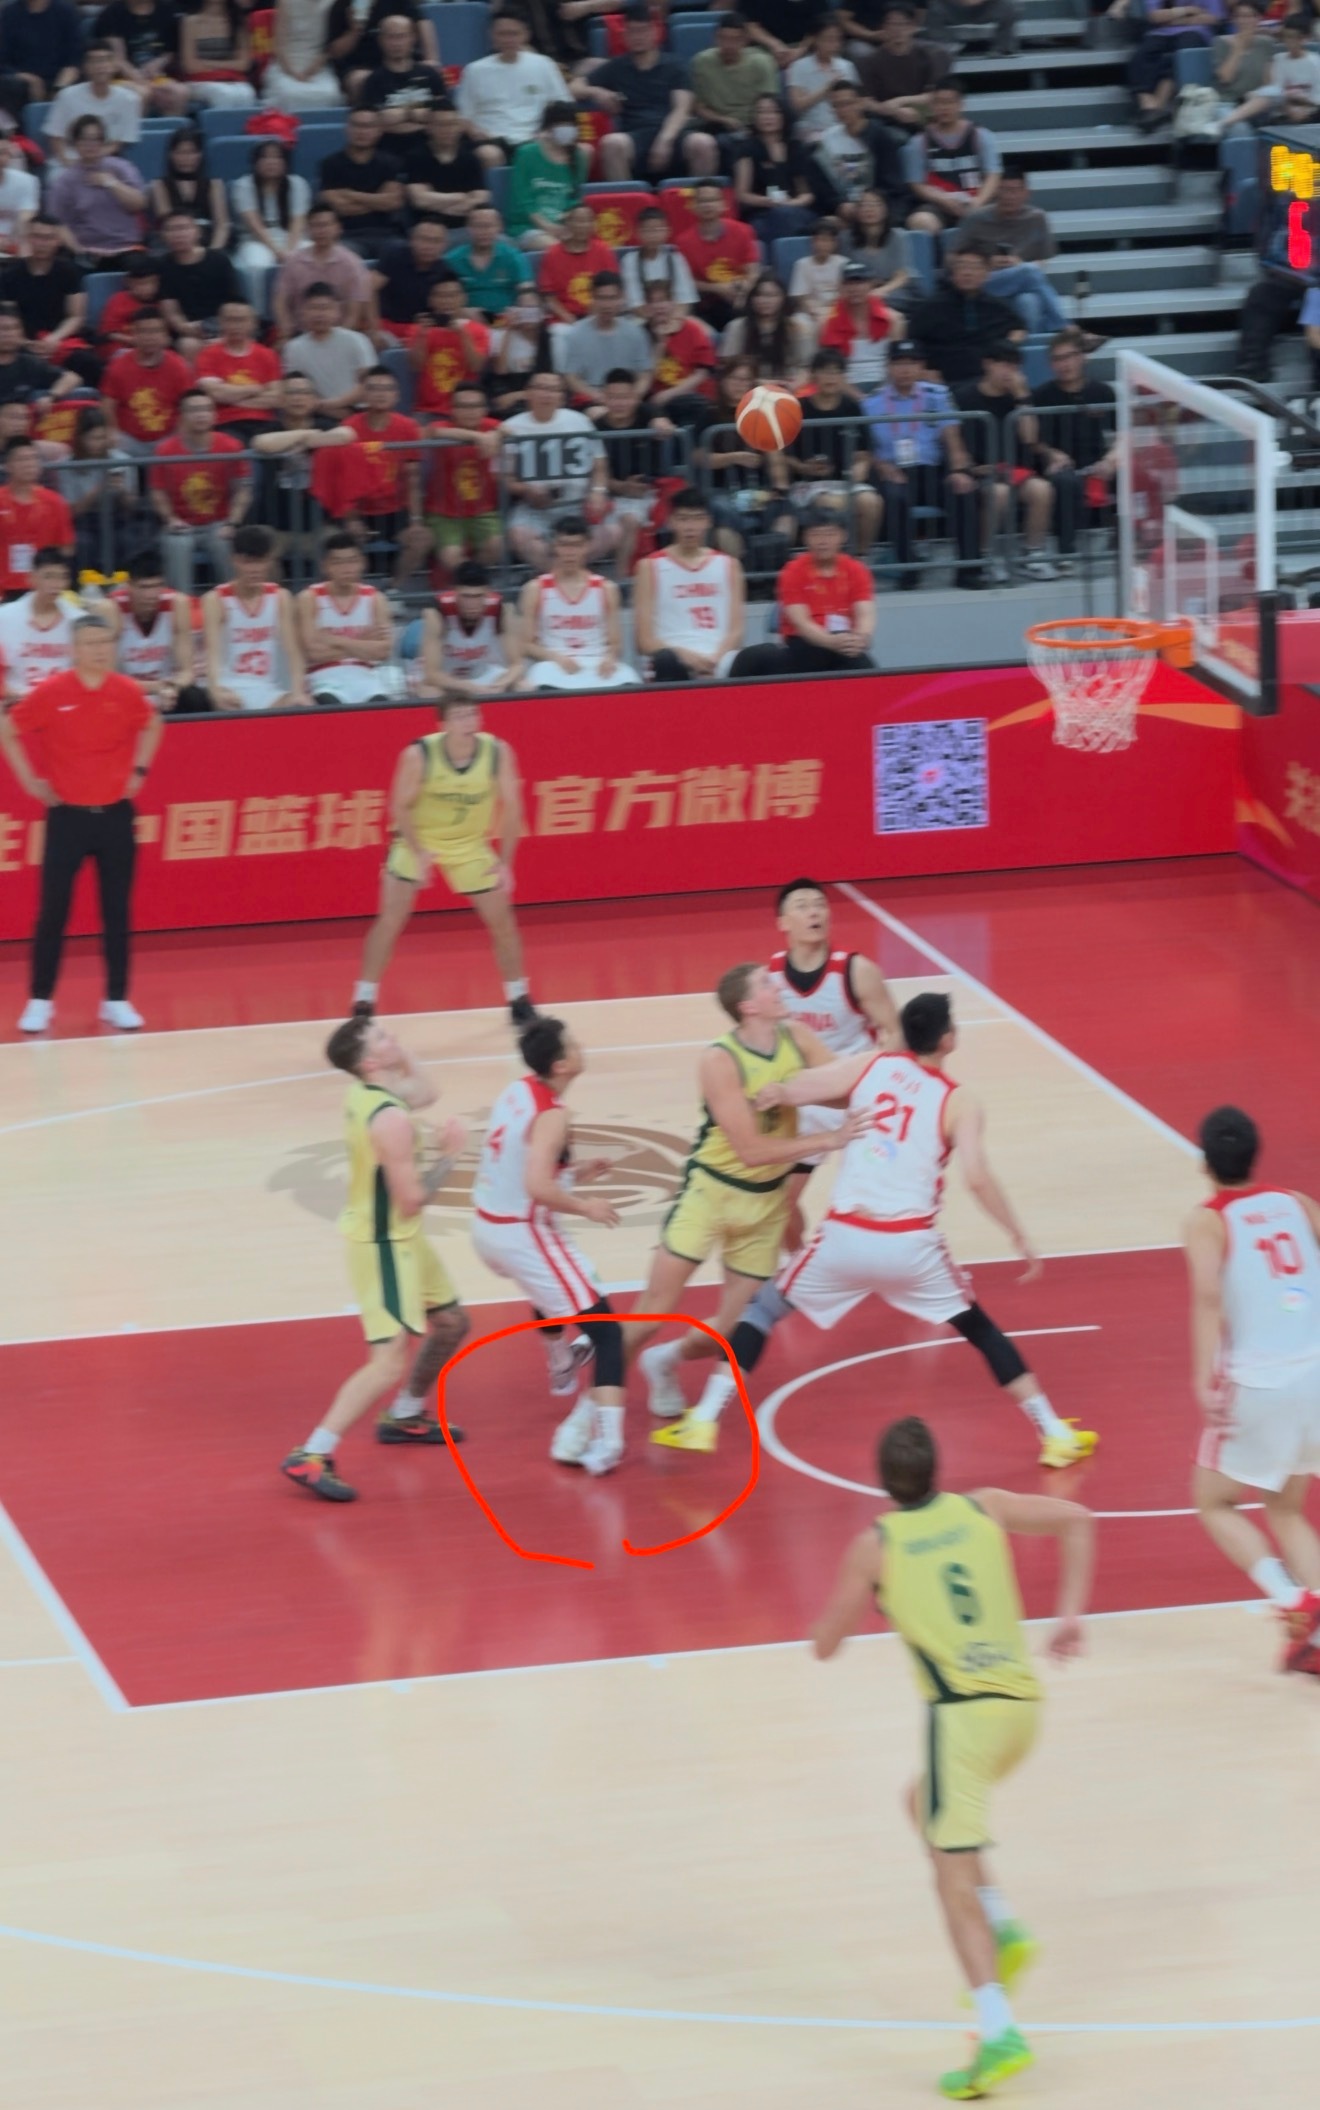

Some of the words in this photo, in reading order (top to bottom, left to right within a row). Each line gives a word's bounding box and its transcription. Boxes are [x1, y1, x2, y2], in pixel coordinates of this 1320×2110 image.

[514, 436, 593, 478] 113
[875, 1092, 915, 1142] 21
[487, 1124, 507, 1163] 4
[1255, 1231, 1305, 1280] 10
[940, 1562, 985, 1627] 6
